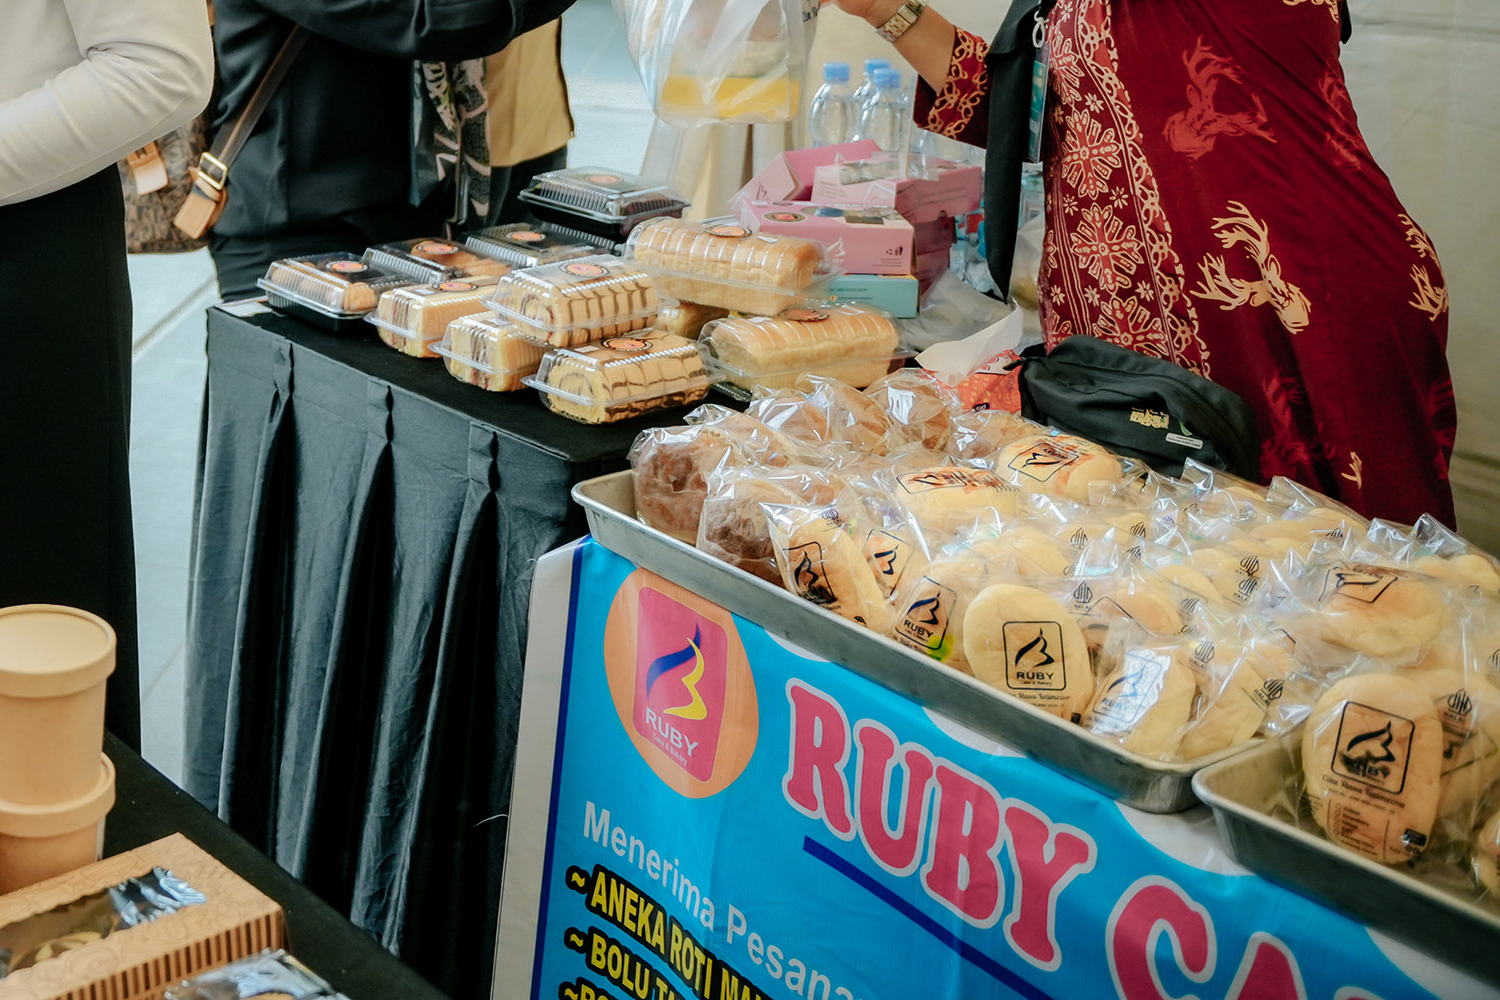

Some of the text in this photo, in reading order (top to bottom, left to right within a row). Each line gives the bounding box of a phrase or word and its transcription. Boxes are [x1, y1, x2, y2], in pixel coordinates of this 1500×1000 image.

[903, 619, 934, 638] RUBY
[1016, 671, 1054, 680] RUBY
[1254, 688, 1270, 706] HALAL
[646, 707, 699, 757] RUBY
[1443, 711, 1466, 723] HALAL
[670, 746, 687, 767] Bakery
[782, 678, 1097, 970] RUBY
[583, 801, 864, 1000] Menerima Pesan
[591, 871, 665, 955] ANEKA
[670, 922, 713, 999] ROTI
[591, 933, 650, 999] BOLU
